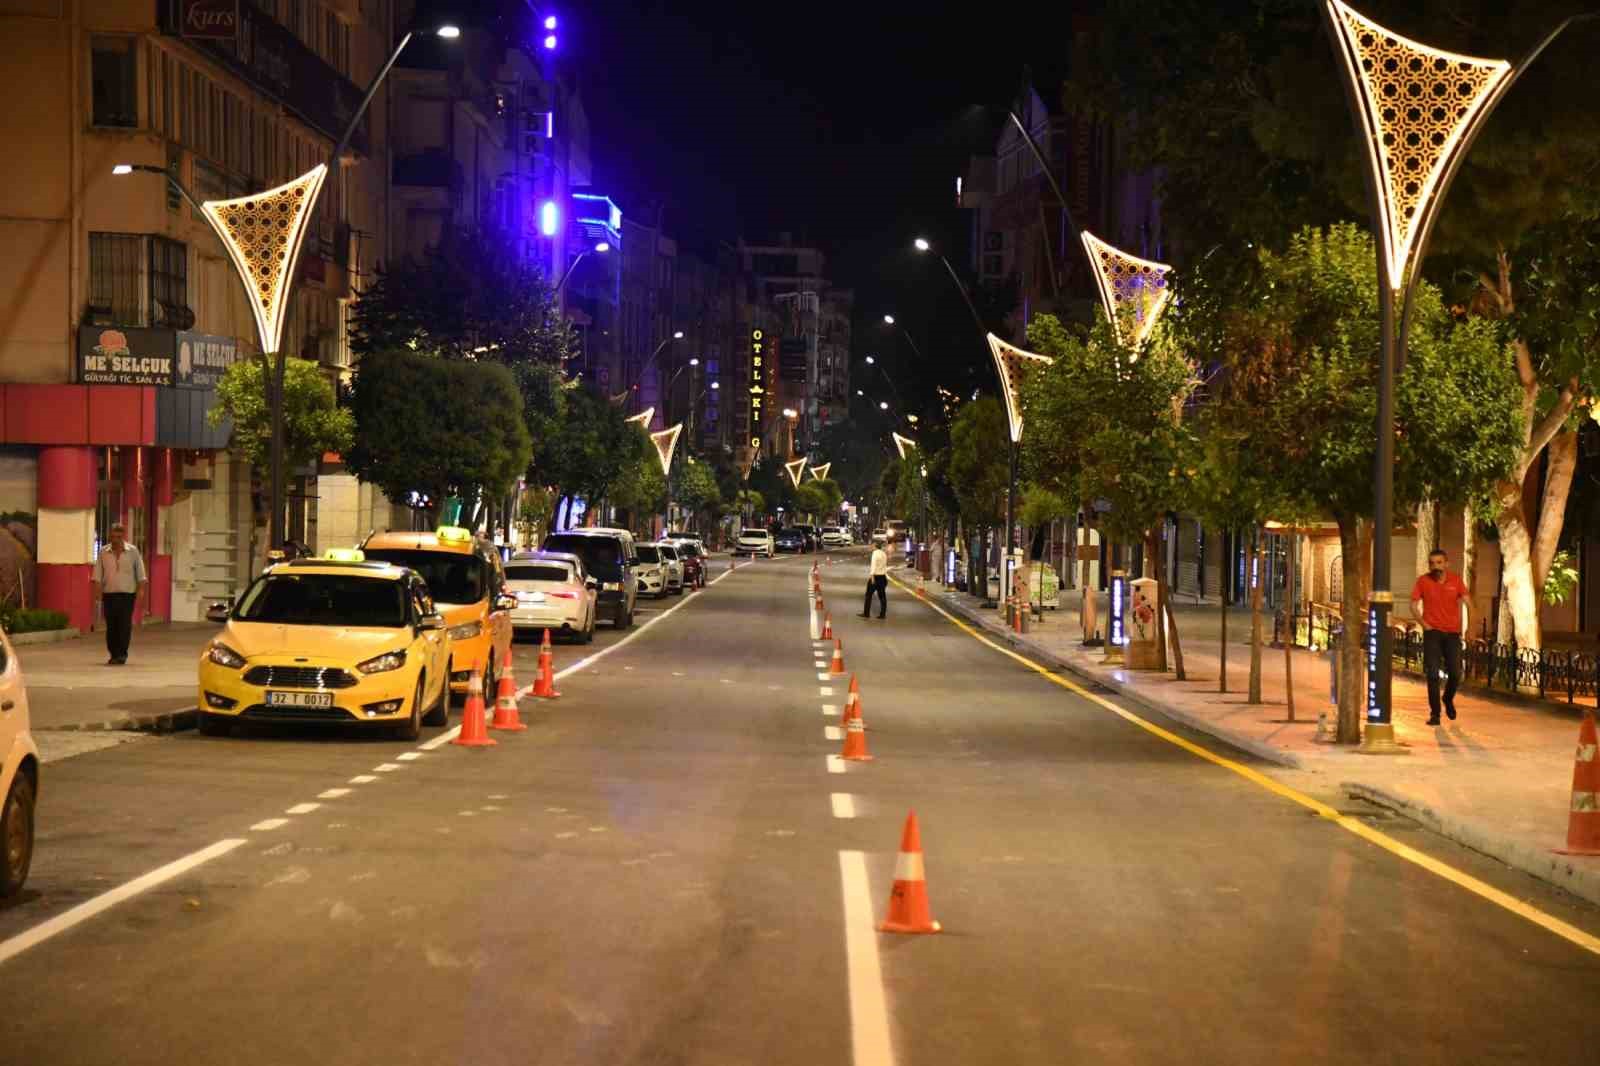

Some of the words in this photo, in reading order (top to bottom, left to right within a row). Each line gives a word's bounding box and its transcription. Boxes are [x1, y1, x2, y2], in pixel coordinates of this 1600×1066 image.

[84, 355, 107, 371] ME
[111, 356, 171, 376] SELÇUK
[752, 397, 761, 447] KIG
[274, 693, 288, 704] 32
[292, 693, 299, 705] T
[304, 694, 330, 706] 0012
